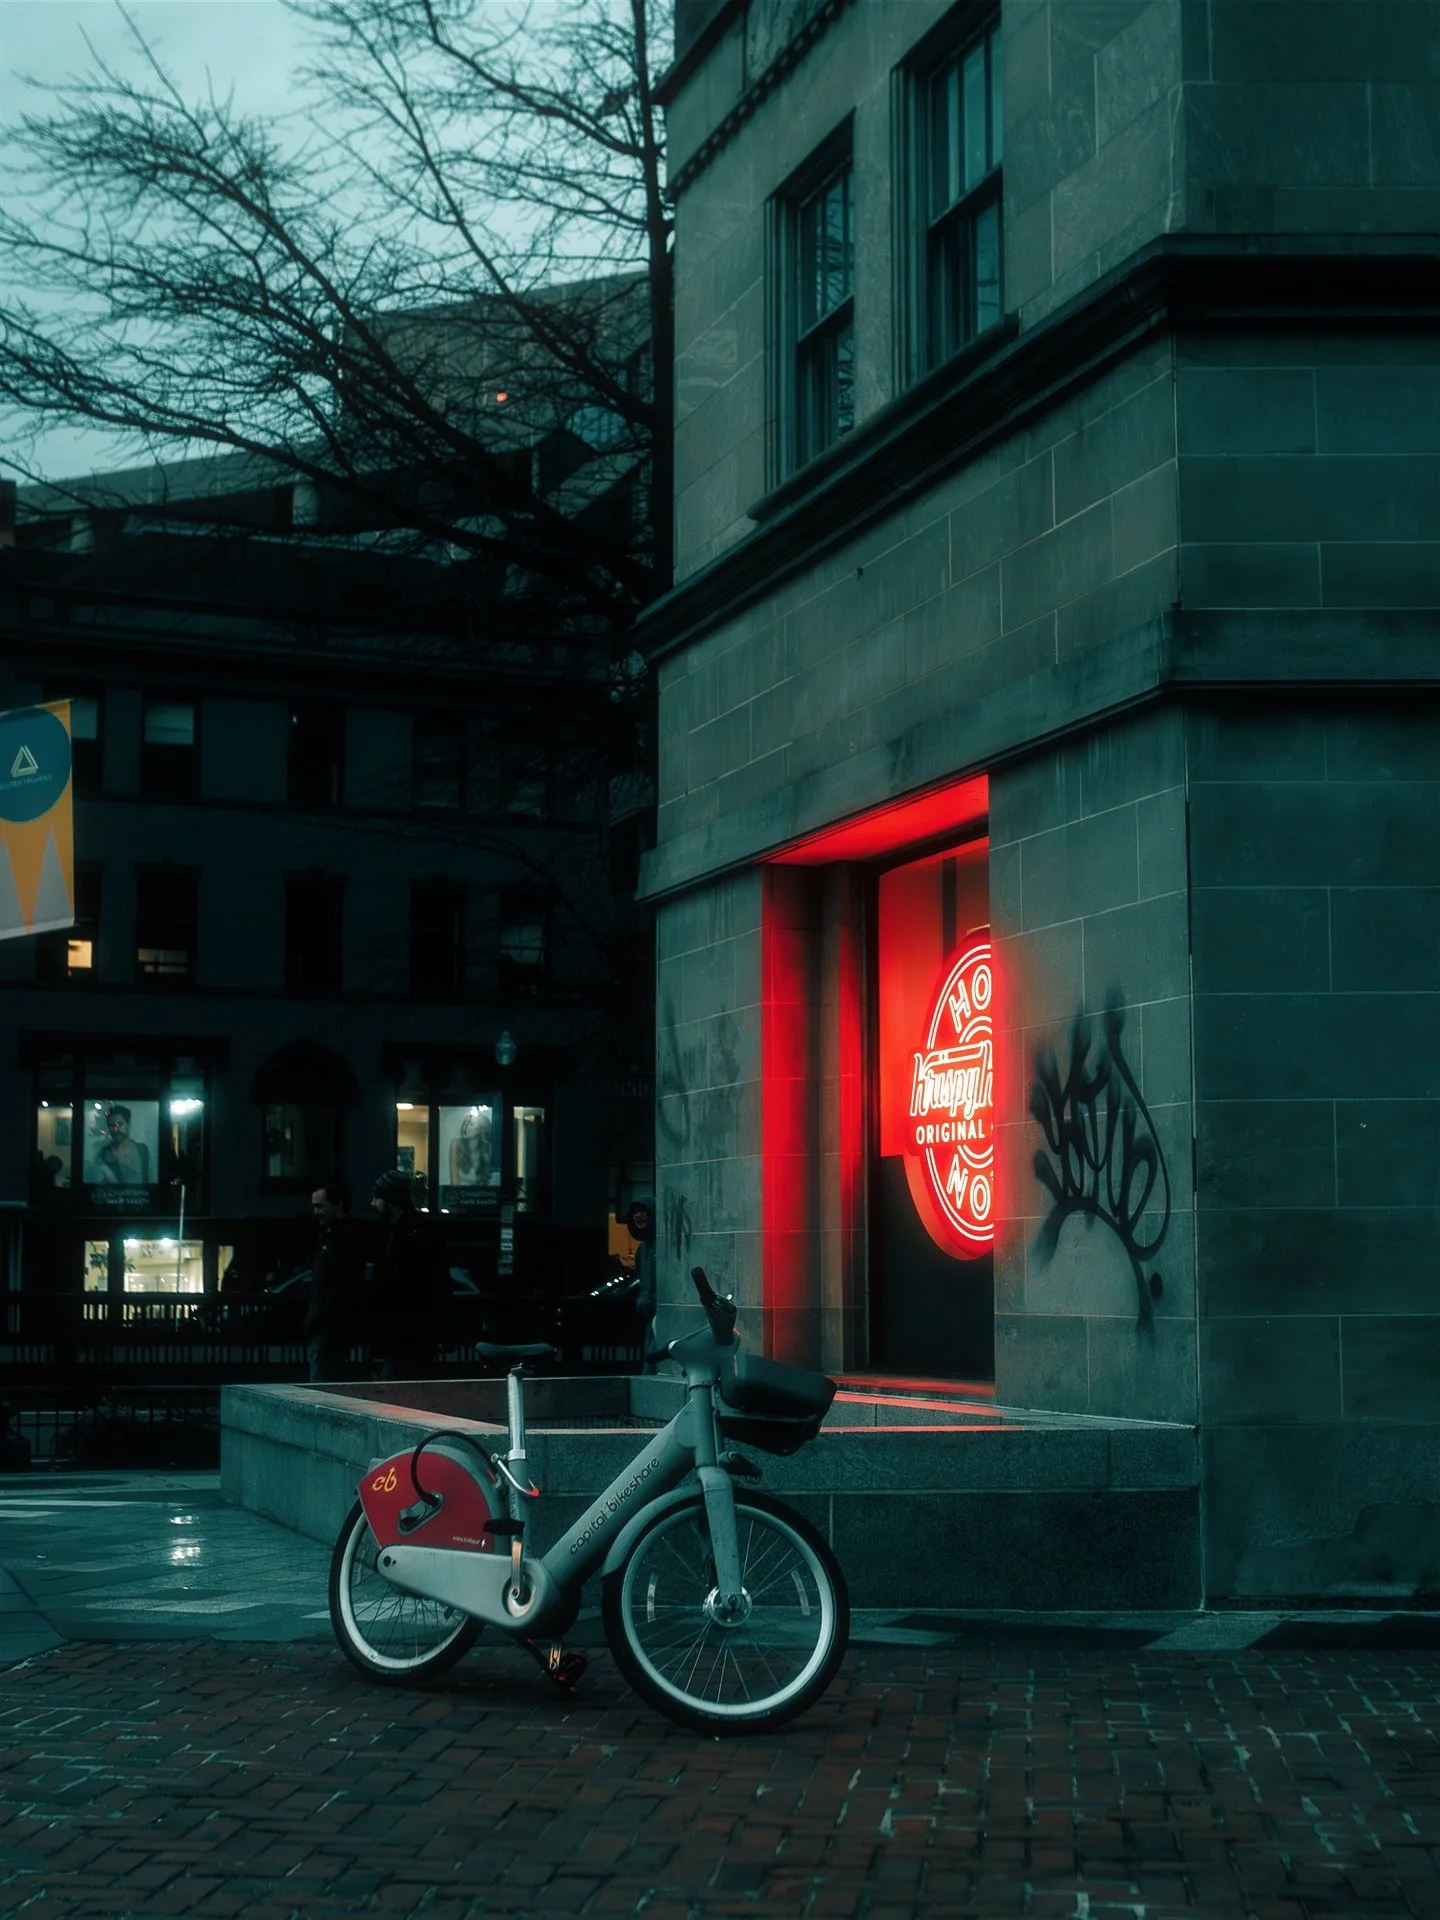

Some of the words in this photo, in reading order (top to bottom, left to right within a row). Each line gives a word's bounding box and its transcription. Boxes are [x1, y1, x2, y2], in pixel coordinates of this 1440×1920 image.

[948, 964, 992, 1034] HO
[909, 1044, 982, 1120] Krispy
[916, 1119, 985, 1145] ORIGINAL
[946, 1153, 994, 1221] NO
[569, 1509, 608, 1555] capital
[605, 1457, 660, 1512] bikeshare
